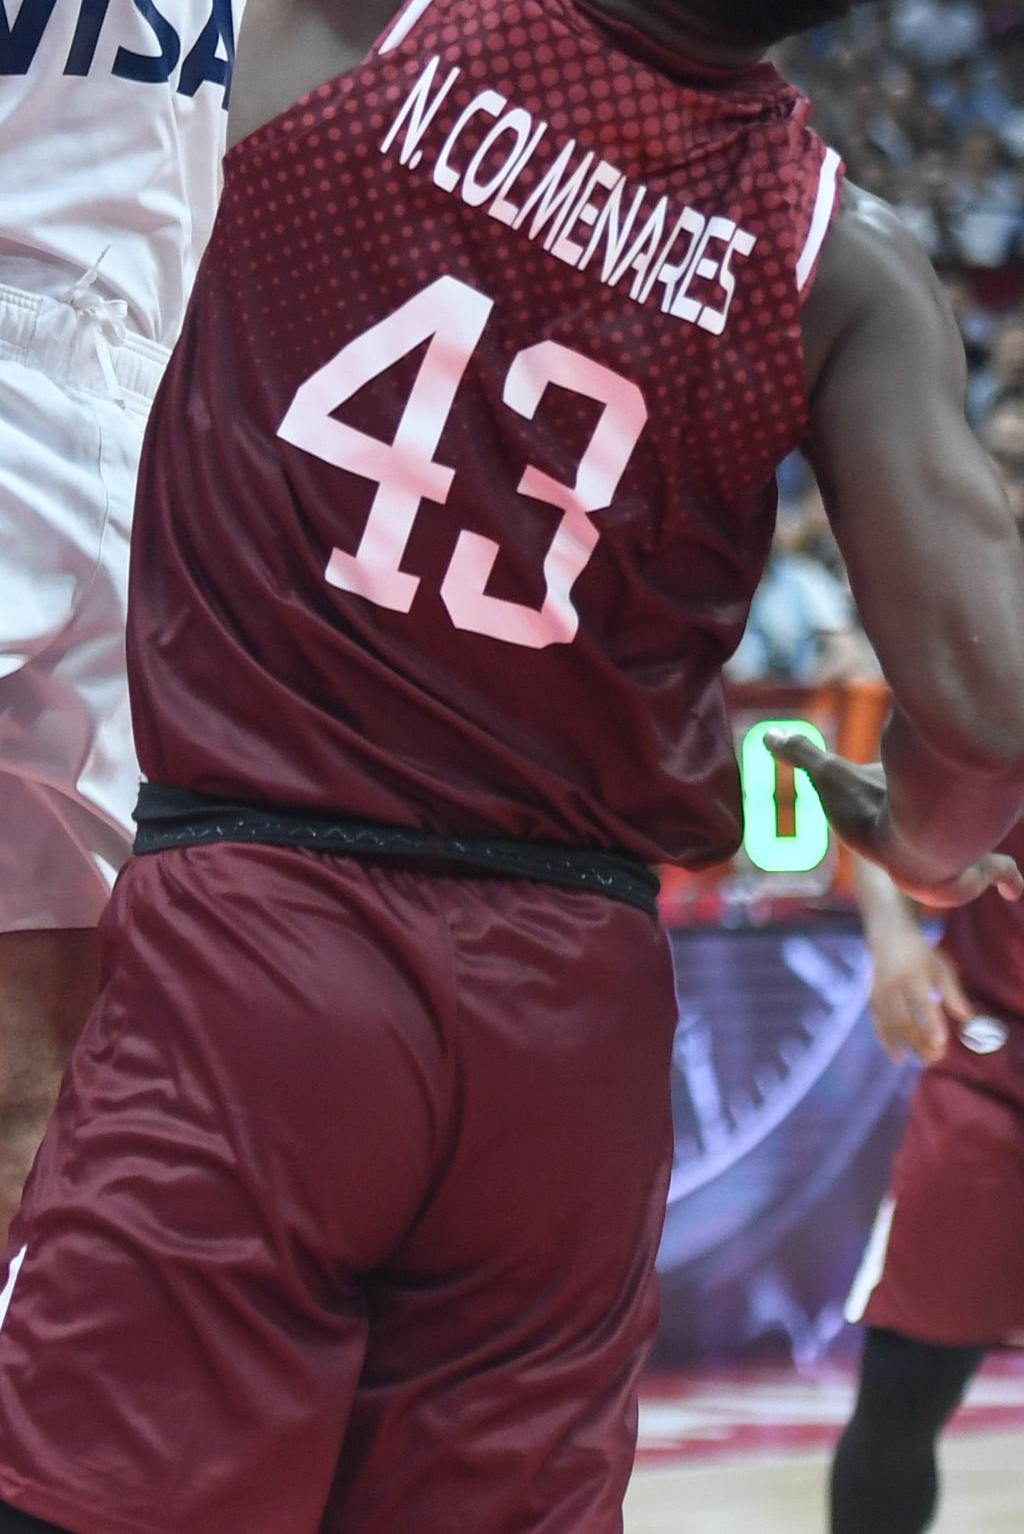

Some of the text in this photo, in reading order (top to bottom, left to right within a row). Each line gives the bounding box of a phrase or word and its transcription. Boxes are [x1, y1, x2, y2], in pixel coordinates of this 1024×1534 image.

[380, 55, 756, 336] N. COLMENARES
[277, 274, 648, 649] 43
[742, 719, 829, 873] 0
